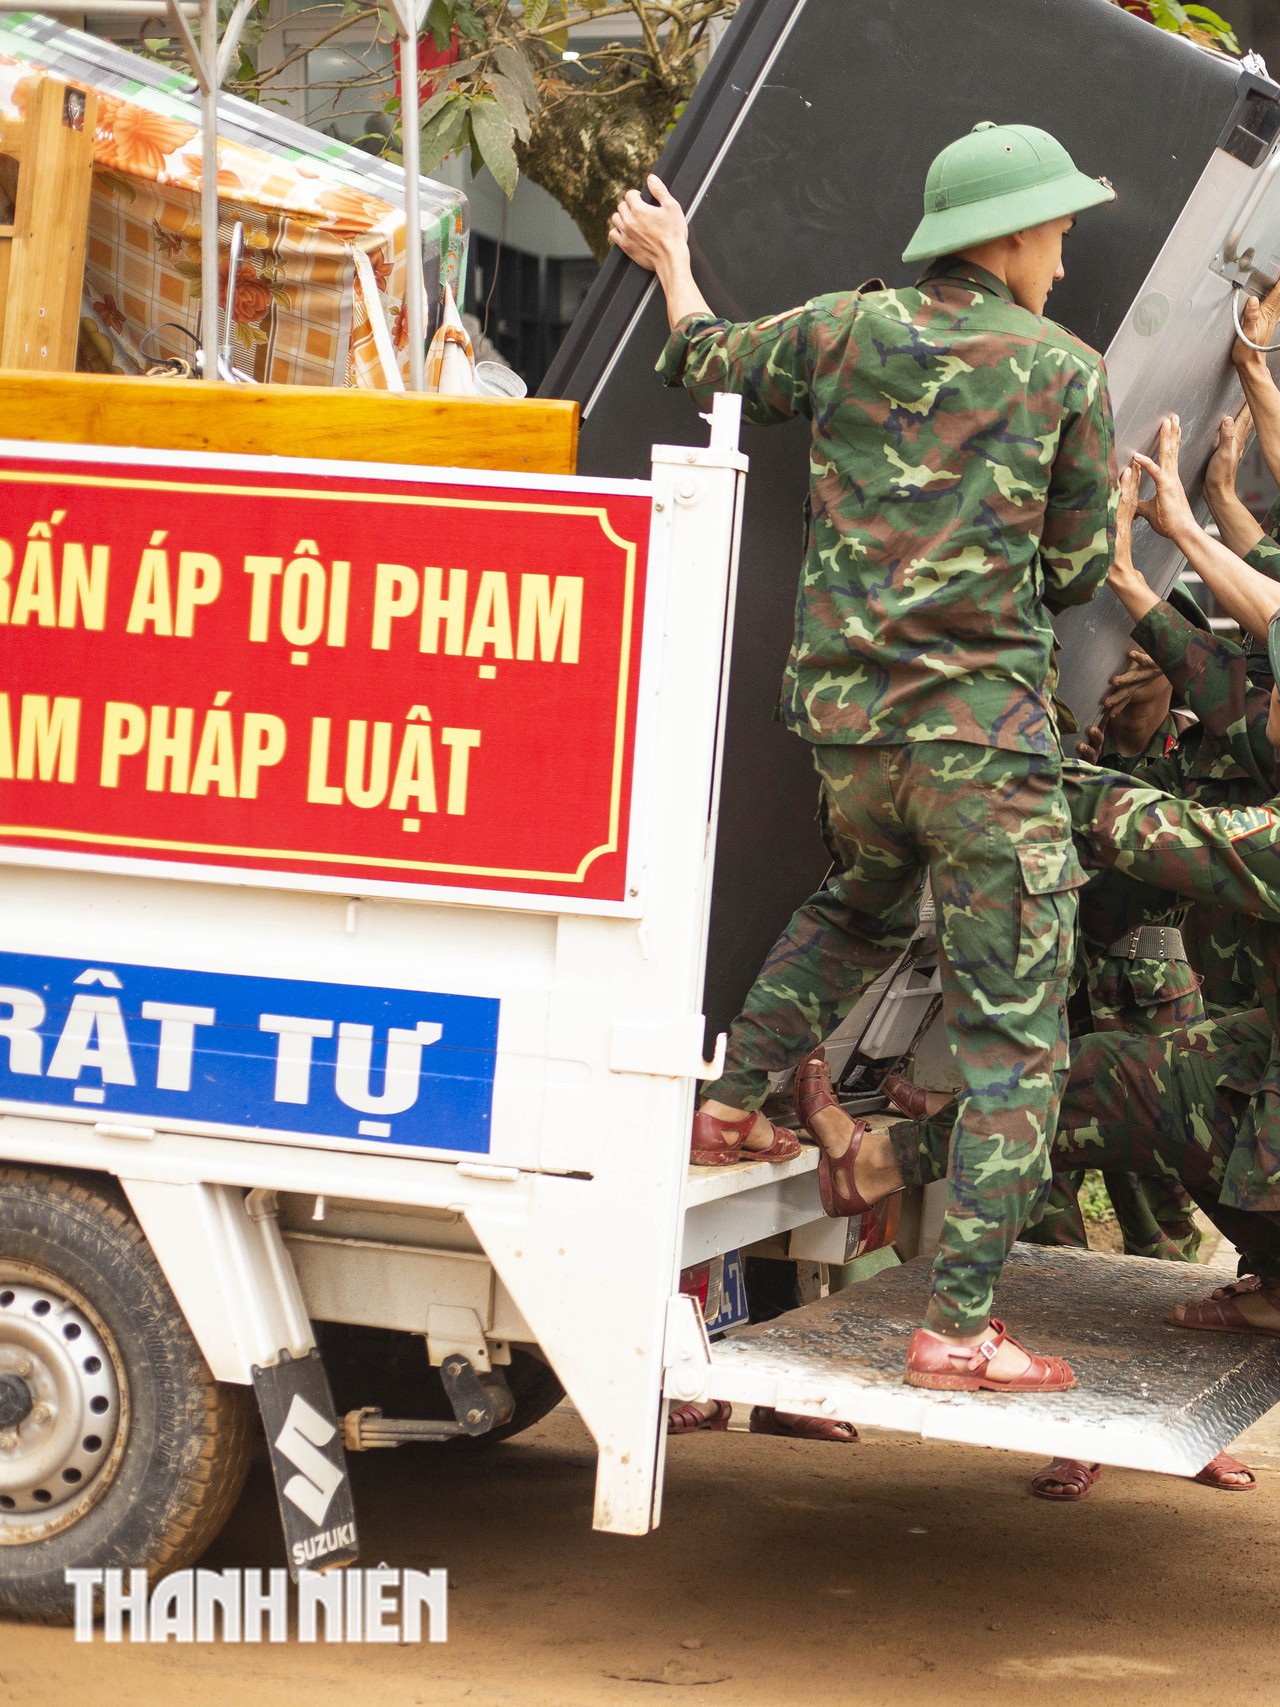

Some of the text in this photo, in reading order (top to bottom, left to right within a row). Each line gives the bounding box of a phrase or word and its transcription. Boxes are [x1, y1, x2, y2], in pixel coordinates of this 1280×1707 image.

[0, 510, 584, 680] ẤN ÁP TỘI PHẠM
[100, 691, 287, 799] PHÁP
[306, 705, 482, 833] LUẬT
[0, 969, 443, 1137] RẬT TỰ
[292, 1522, 356, 1565] SUZUKI
